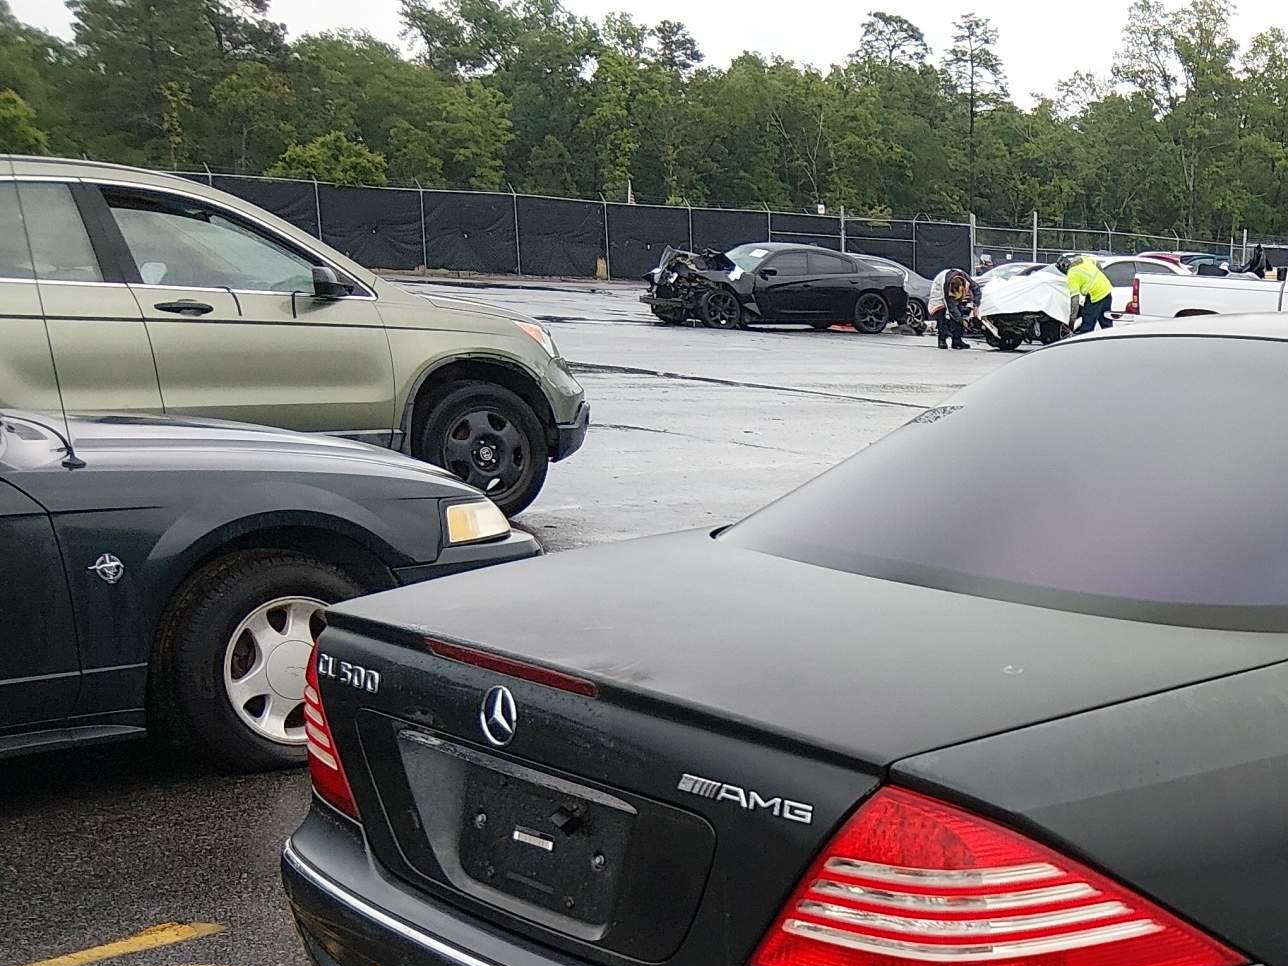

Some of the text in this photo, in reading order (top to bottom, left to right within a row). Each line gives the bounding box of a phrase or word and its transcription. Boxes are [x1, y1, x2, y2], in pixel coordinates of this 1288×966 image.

[319, 653, 381, 694] CL 500
[716, 783, 814, 824] AMG
